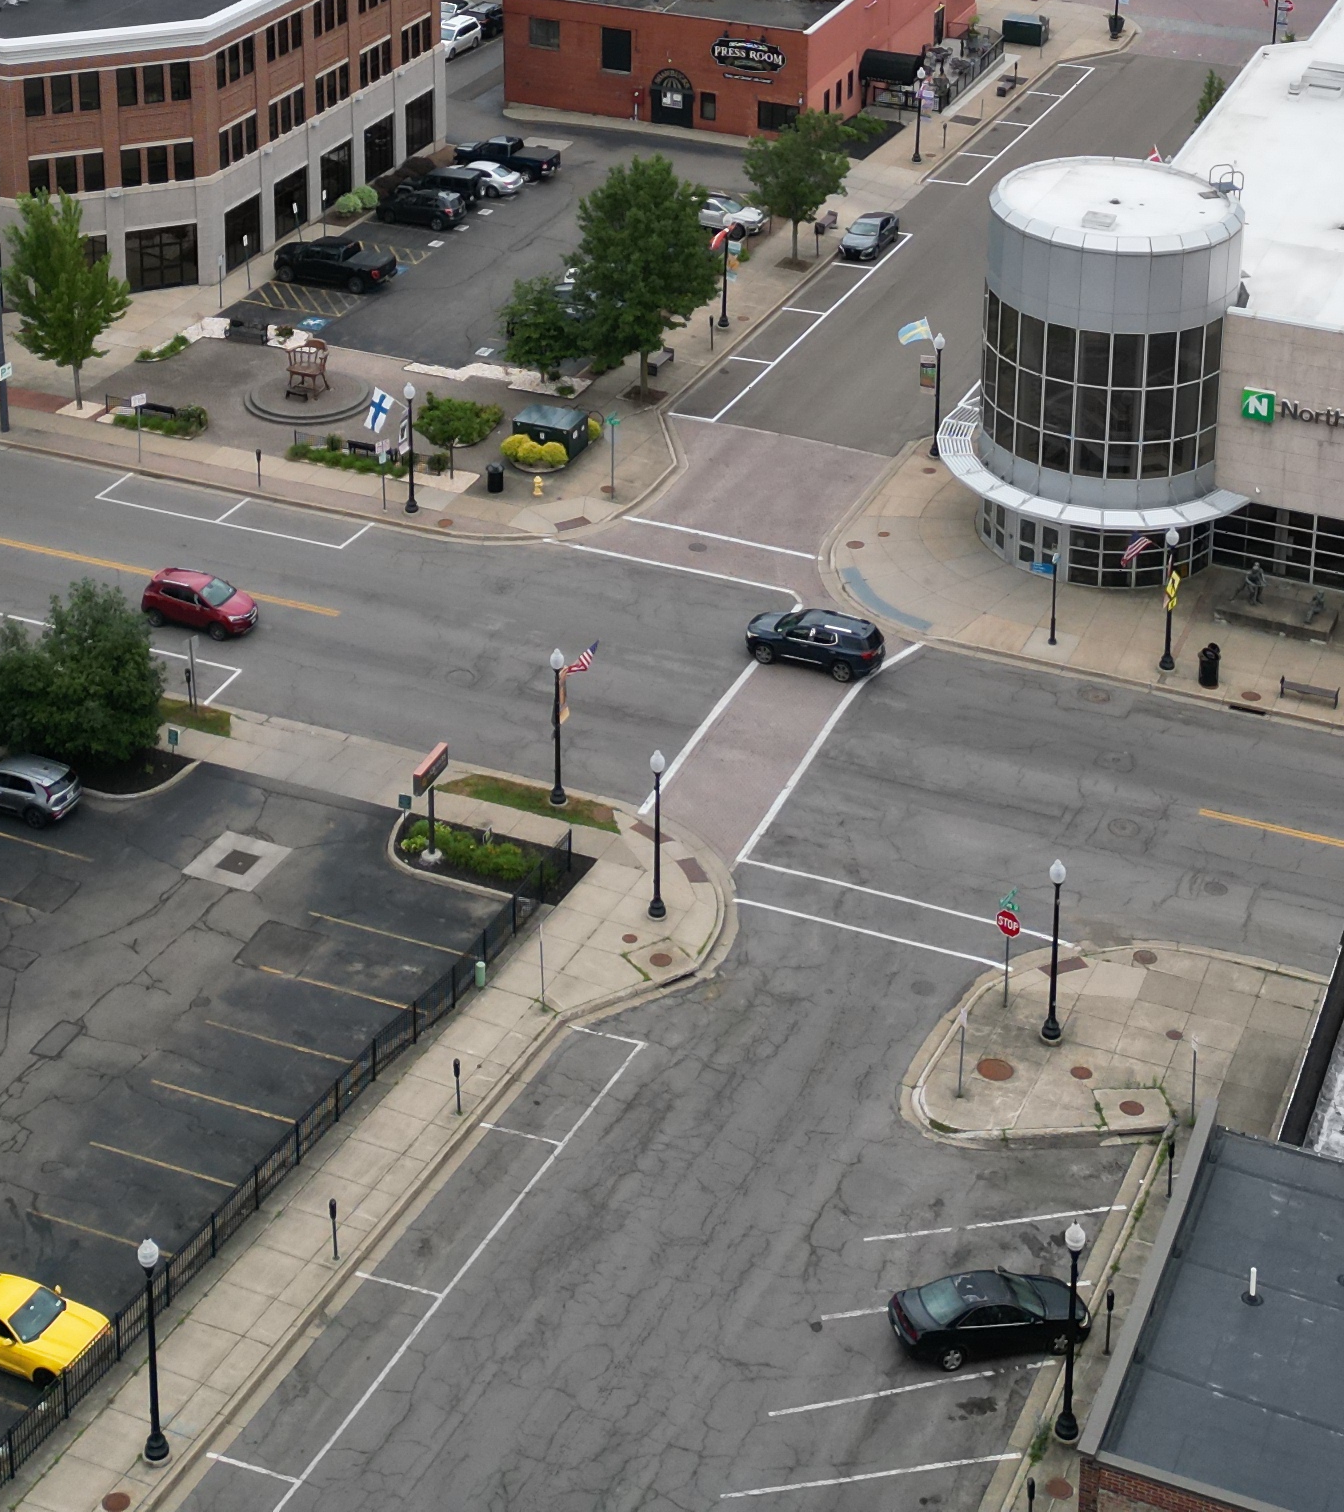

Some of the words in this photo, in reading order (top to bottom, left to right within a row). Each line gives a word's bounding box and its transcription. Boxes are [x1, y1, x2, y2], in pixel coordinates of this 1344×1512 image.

[714, 45, 746, 58] PRESS
[749, 50, 783, 66] ROOM
[997, 915, 1019, 932] STOP
